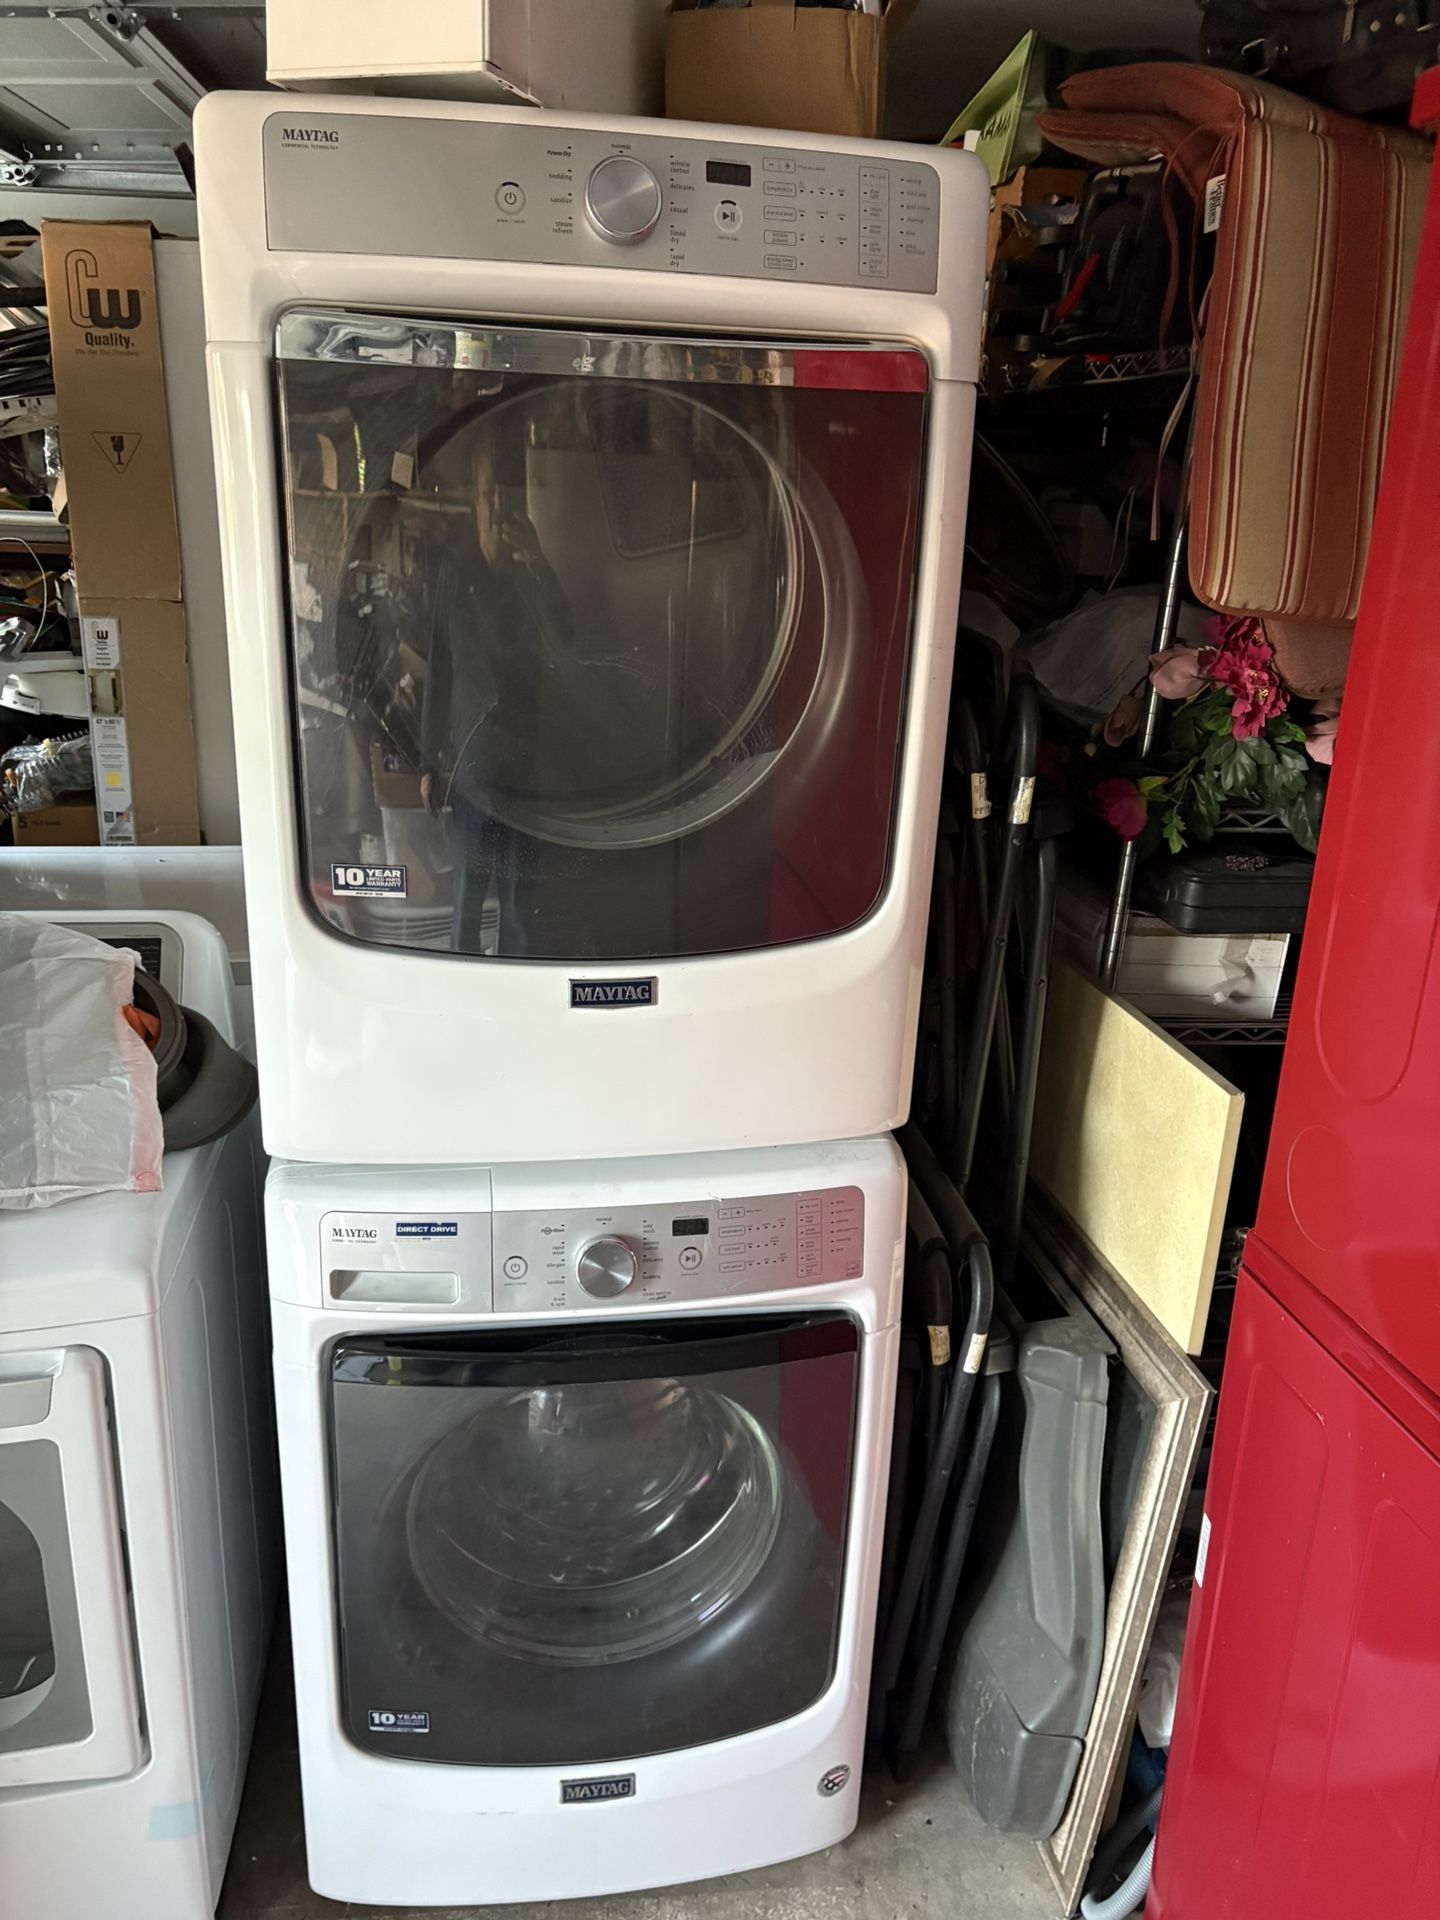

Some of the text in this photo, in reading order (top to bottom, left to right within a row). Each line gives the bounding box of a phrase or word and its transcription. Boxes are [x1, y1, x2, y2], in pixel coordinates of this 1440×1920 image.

[282, 128, 339, 142] MAYTAG
[548, 173, 573, 181] bedding
[670, 183, 695, 191] delicates
[670, 237, 680, 245] dry
[670, 254, 685, 262] rapid
[670, 260, 680, 269] dry
[85, 331, 135, 349] Quality.
[336, 868, 401, 886] 10 YEAR
[574, 985, 650, 1002] MAYTAG
[331, 1228, 377, 1239] MAYTAG
[372, 1713, 396, 1725] 10
[565, 1781, 629, 1800] MAYTAG
